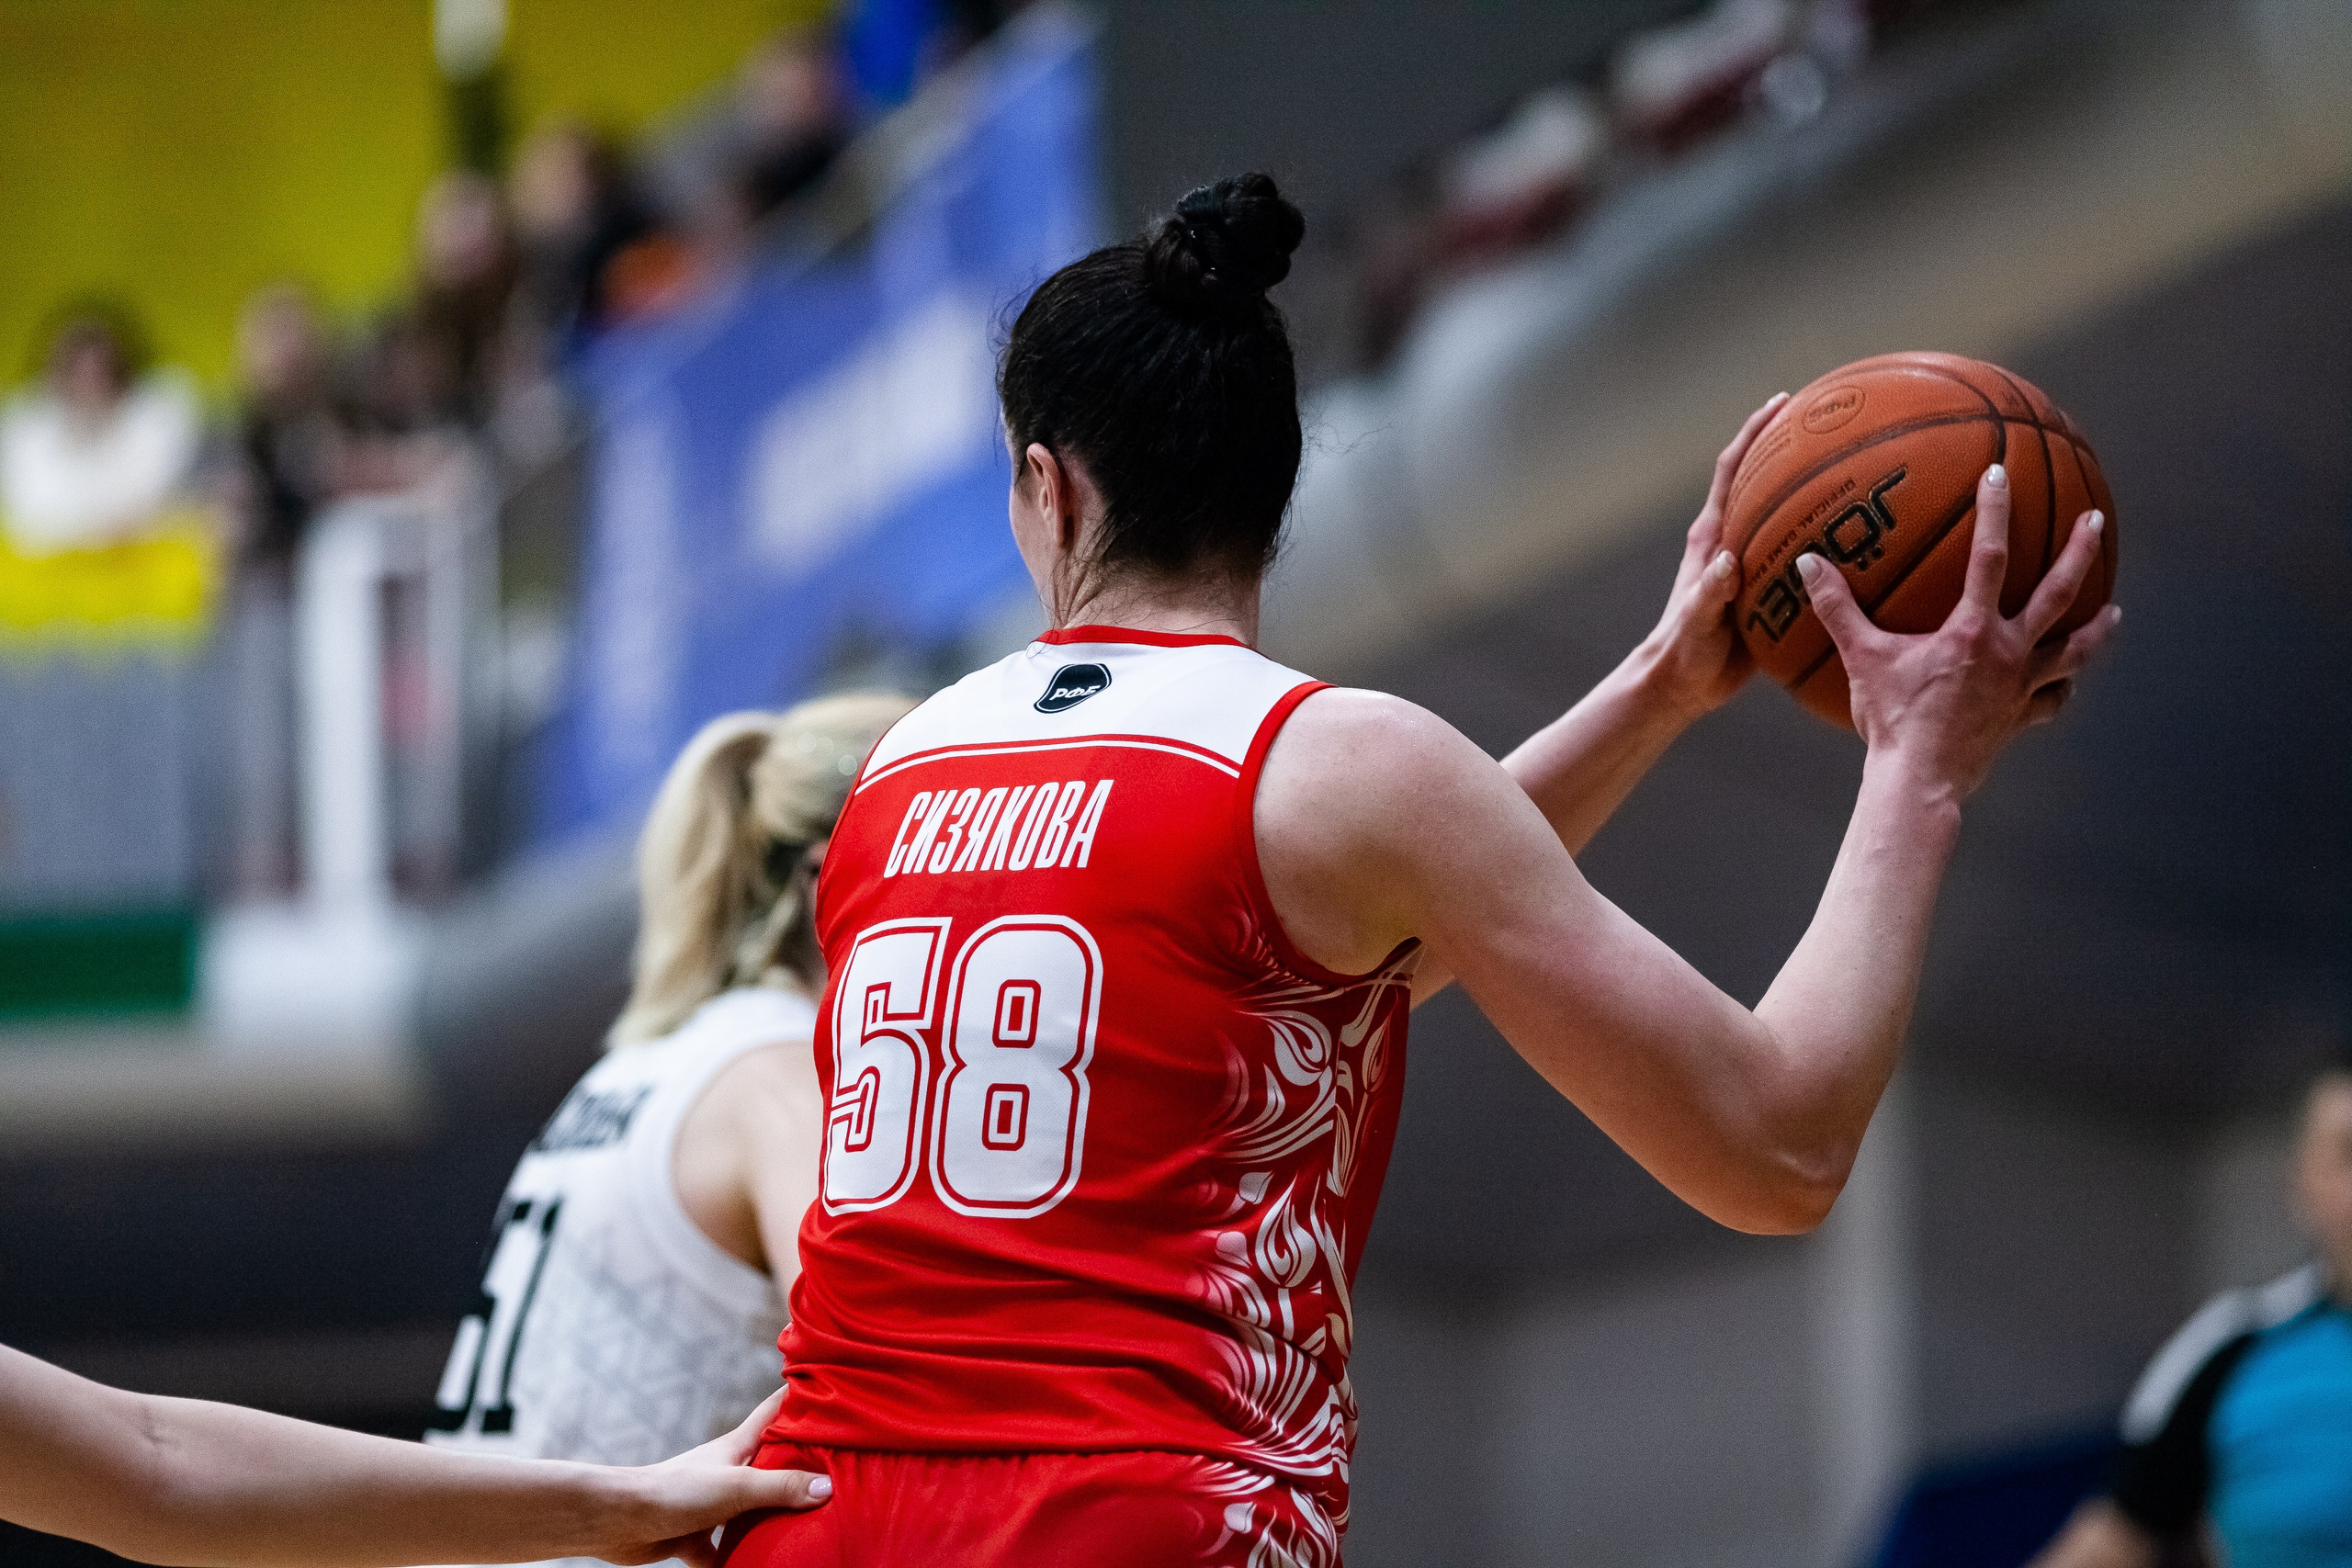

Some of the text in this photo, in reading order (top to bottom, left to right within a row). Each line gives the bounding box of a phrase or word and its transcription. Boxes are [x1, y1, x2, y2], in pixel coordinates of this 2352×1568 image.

[1800, 479, 1856, 529] OFFICIAL
[1767, 529, 1798, 562] GAME
[1049, 684, 1101, 701] РФБ
[883, 779, 1114, 878] СИЗЯКОВА
[822, 914, 1104, 1218] 58
